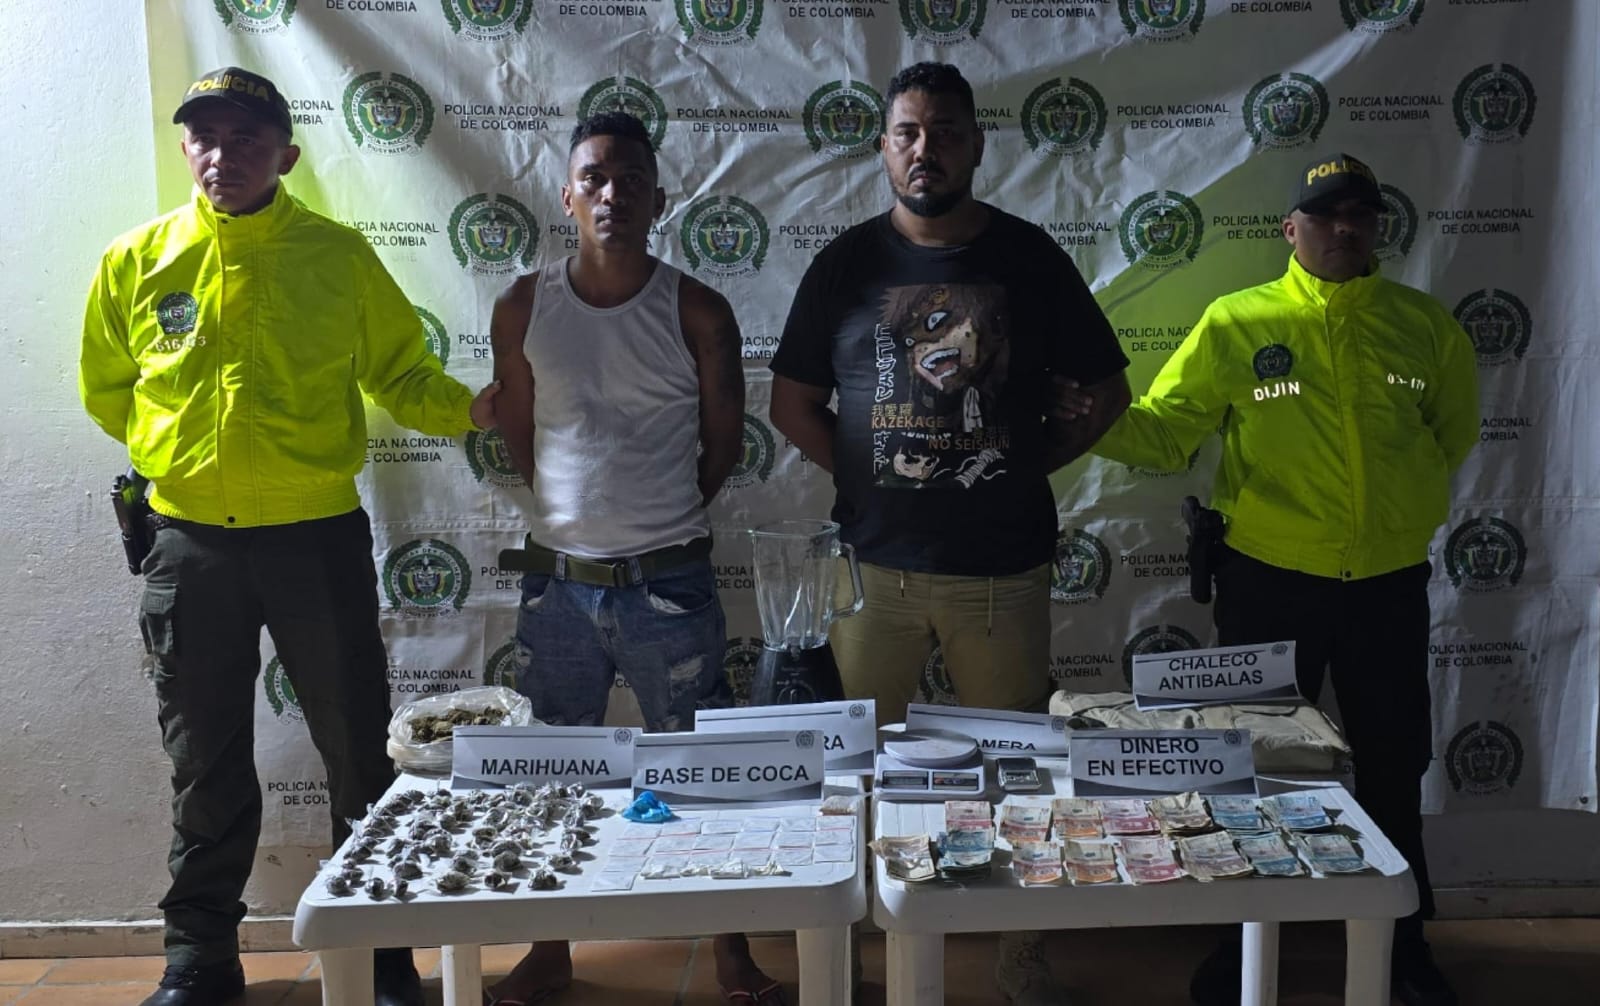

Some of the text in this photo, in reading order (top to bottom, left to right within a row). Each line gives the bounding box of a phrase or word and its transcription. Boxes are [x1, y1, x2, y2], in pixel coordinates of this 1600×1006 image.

[326, 0, 417, 12] DE COLOMBIA
[559, 5, 647, 16] DE COLOMBIA
[1231, 1, 1312, 13] DE COLOMBIA
[789, 7, 875, 18] DE COLOMBIA
[1011, 8, 1096, 19] DE COLOMBIA
[187, 74, 269, 101] POLICIA
[1338, 94, 1445, 108] POLICIA NACIONAL
[444, 104, 563, 117] POLICIA NACIONAL
[677, 108, 792, 119] POLICIA NACIONAL
[1117, 103, 1230, 117] POLICIA NACIONAL
[1350, 110, 1430, 121] DE COLOMBIA
[293, 115, 323, 125] MBIA
[460, 119, 549, 130] DE COLOMBIA
[1131, 117, 1216, 130] DE COLOMBIA
[693, 122, 779, 133] DE COLOMBIA
[1427, 207, 1535, 221] POLICIA NACIONAL
[1213, 214, 1259, 227] POLICIA
[380, 221, 439, 233] NACIONAL
[550, 225, 578, 236] POLI
[779, 225, 828, 236] POLICIA
[1049, 221, 1111, 233] NACIONAL
[1441, 222, 1520, 235] DE COLOMBIA
[1227, 228, 1284, 240] DE COLO
[367, 236, 427, 247] COLOMBIA
[565, 239, 580, 249] DE
[794, 239, 811, 249] DE
[1058, 235, 1097, 247] OMBIA
[1117, 327, 1164, 339] POLICIA
[458, 334, 492, 345] POLIC
[473, 348, 489, 358] DE
[1131, 342, 1148, 352] DE
[1253, 380, 1301, 401] DIJIN
[871, 415, 945, 429] KAZEKAGE
[1480, 417, 1532, 428] ACIONAL
[1480, 431, 1520, 442] OMBIA
[391, 438, 456, 449] NACIONAL
[928, 438, 1010, 450] NO SEISHUN
[373, 452, 442, 463] COLOMBIA
[1120, 554, 1166, 565] POLICIA
[1134, 566, 1190, 578] DE COLO
[496, 580, 512, 590] DE
[715, 579, 732, 589] DE
[1429, 640, 1529, 655] OLICIA NACIONAL
[1057, 654, 1115, 666] NACIONAL
[1168, 652, 1258, 671] CHALECO
[1435, 655, 1513, 668] DE COLOMBIA
[413, 669, 475, 680] NACIONAL
[1050, 667, 1102, 679] OLOMBIA
[1159, 669, 1264, 690] ANTIBALAS
[397, 683, 461, 693] COLOMBIA
[1120, 737, 1199, 754] DINERO
[481, 759, 610, 776] MARIHUANA
[1088, 758, 1225, 777] EN EFECTIVO
[645, 765, 809, 785] BASE DE COCA
[268, 781, 316, 792] POLICIA
[283, 795, 300, 805] DE
